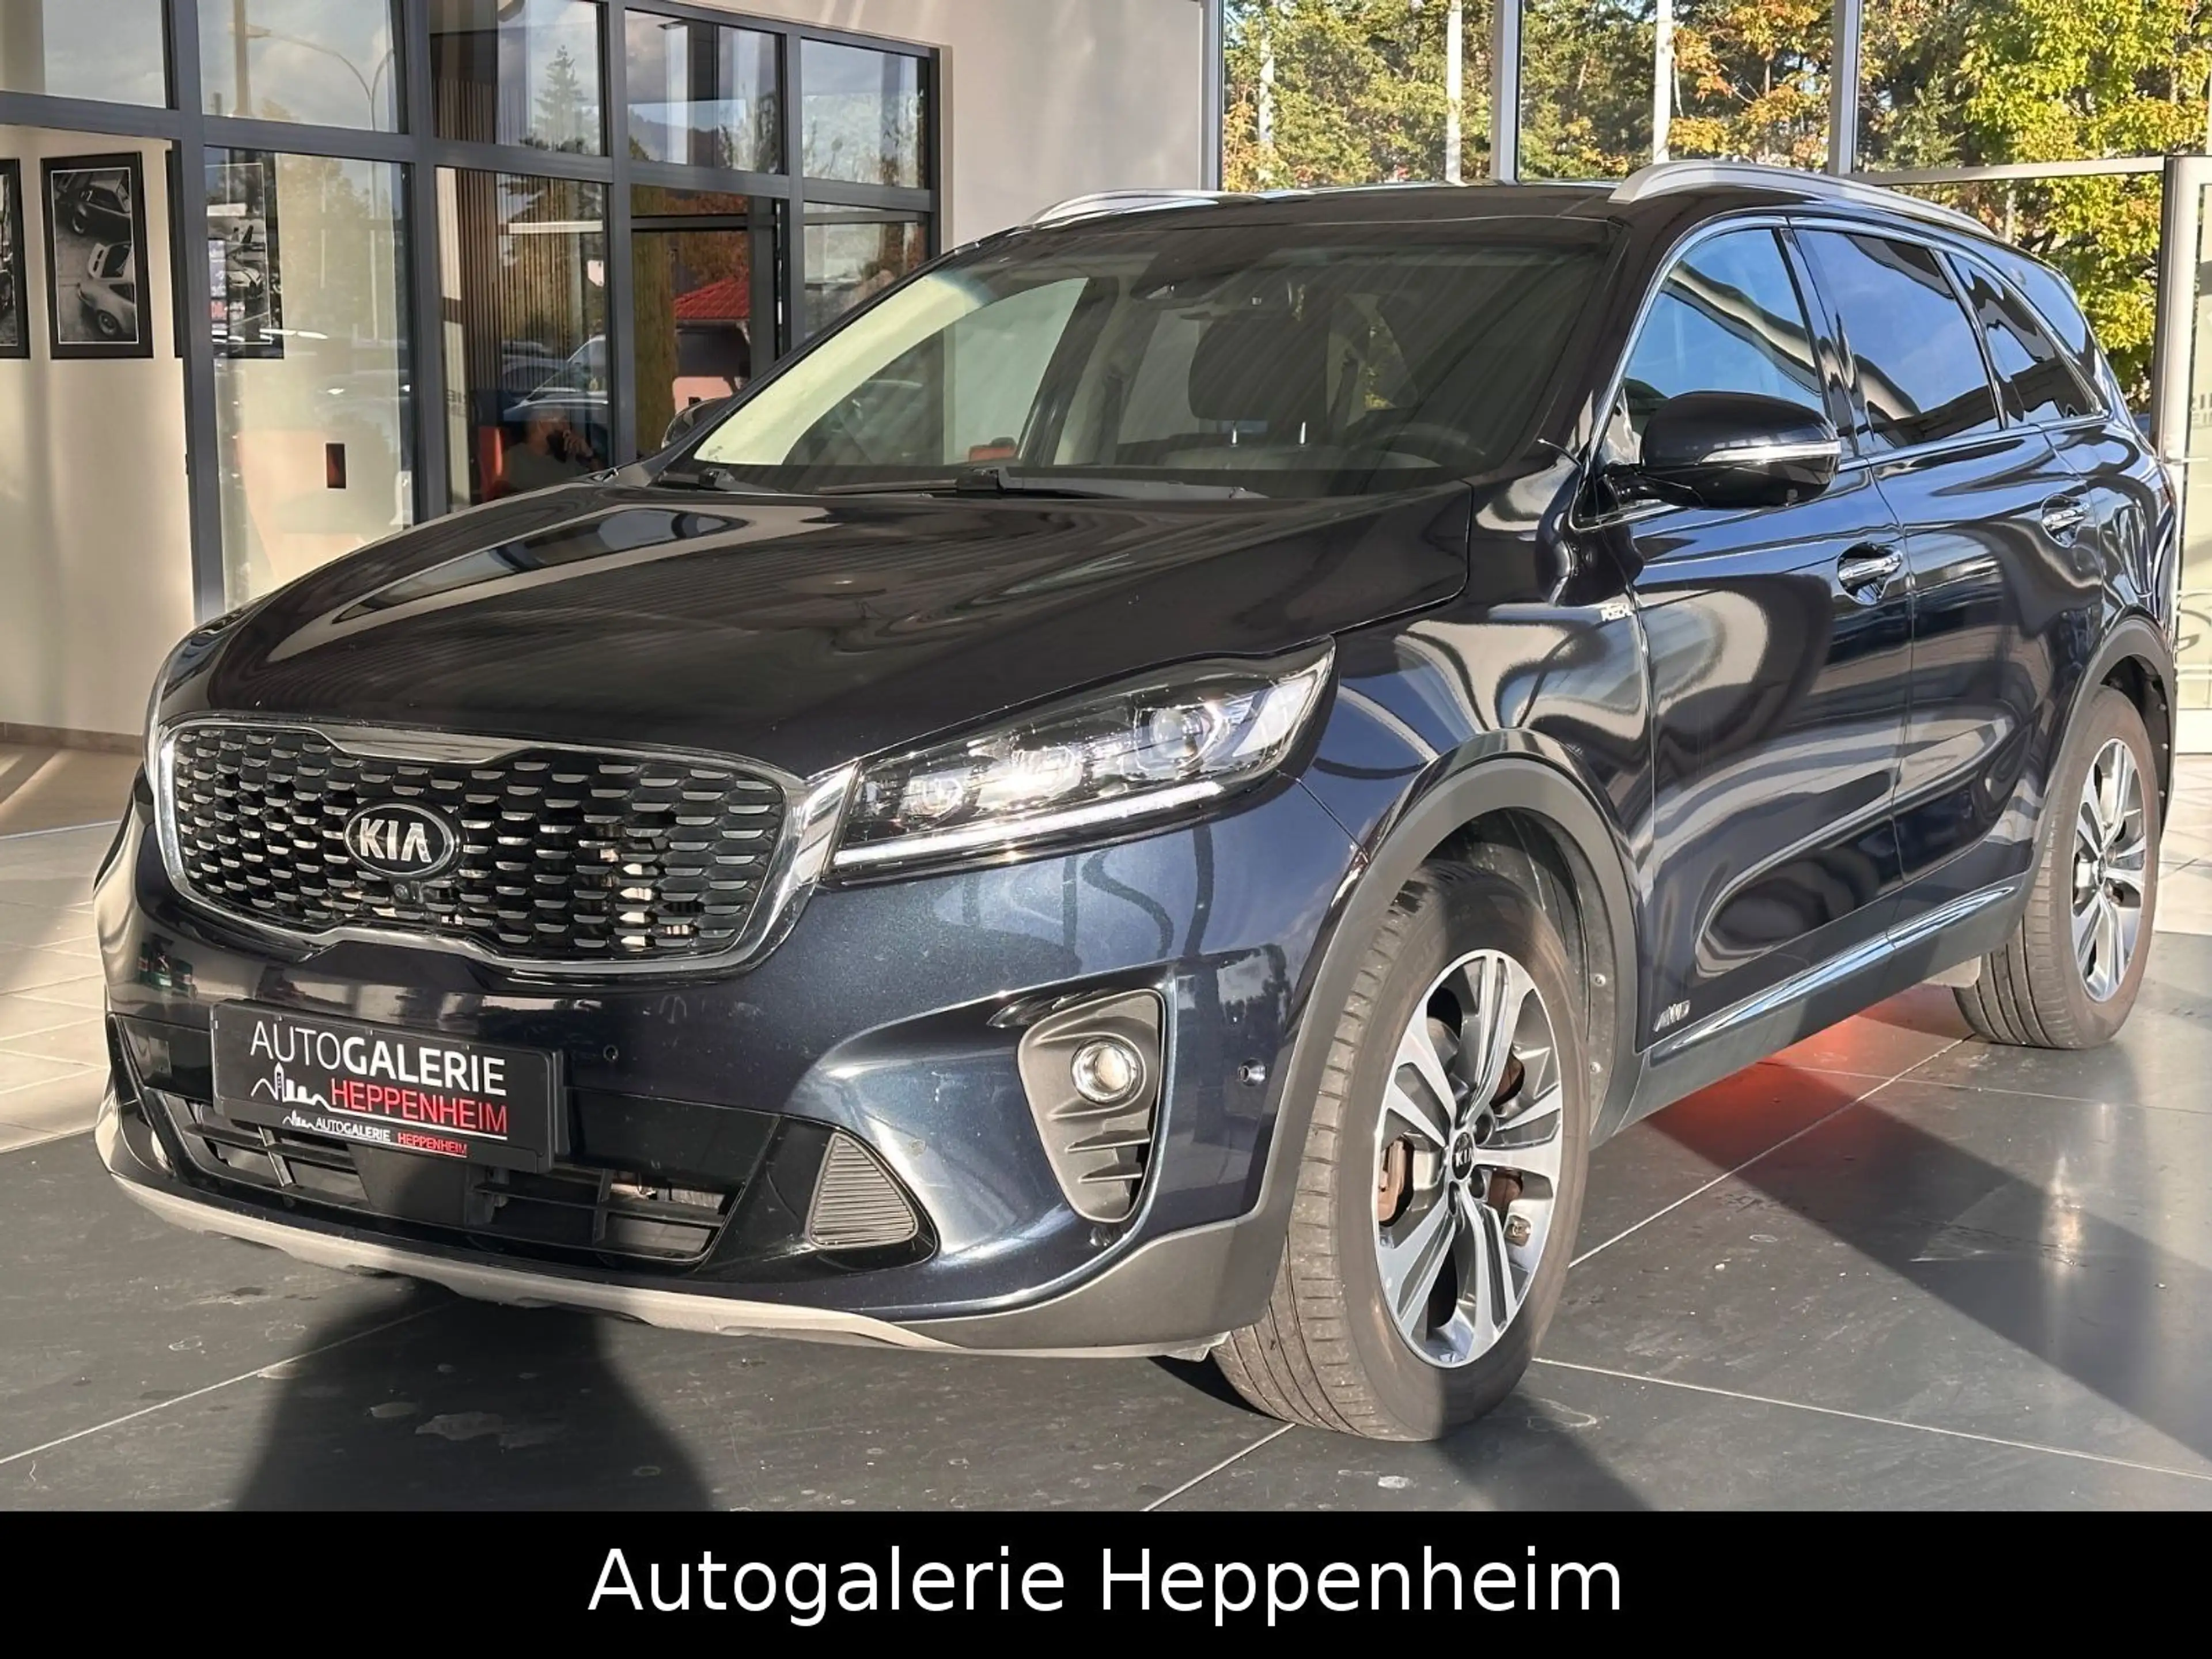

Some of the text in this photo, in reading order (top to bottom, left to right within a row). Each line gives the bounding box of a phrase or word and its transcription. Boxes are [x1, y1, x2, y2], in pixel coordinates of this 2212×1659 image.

[359, 818, 431, 862] KIA
[250, 1020, 507, 1097] AUTOGALERIE
[331, 1077, 507, 1134] HEPPENHEIM
[315, 1116, 468, 1154] AUTOGALERIE HEPPENHEIM
